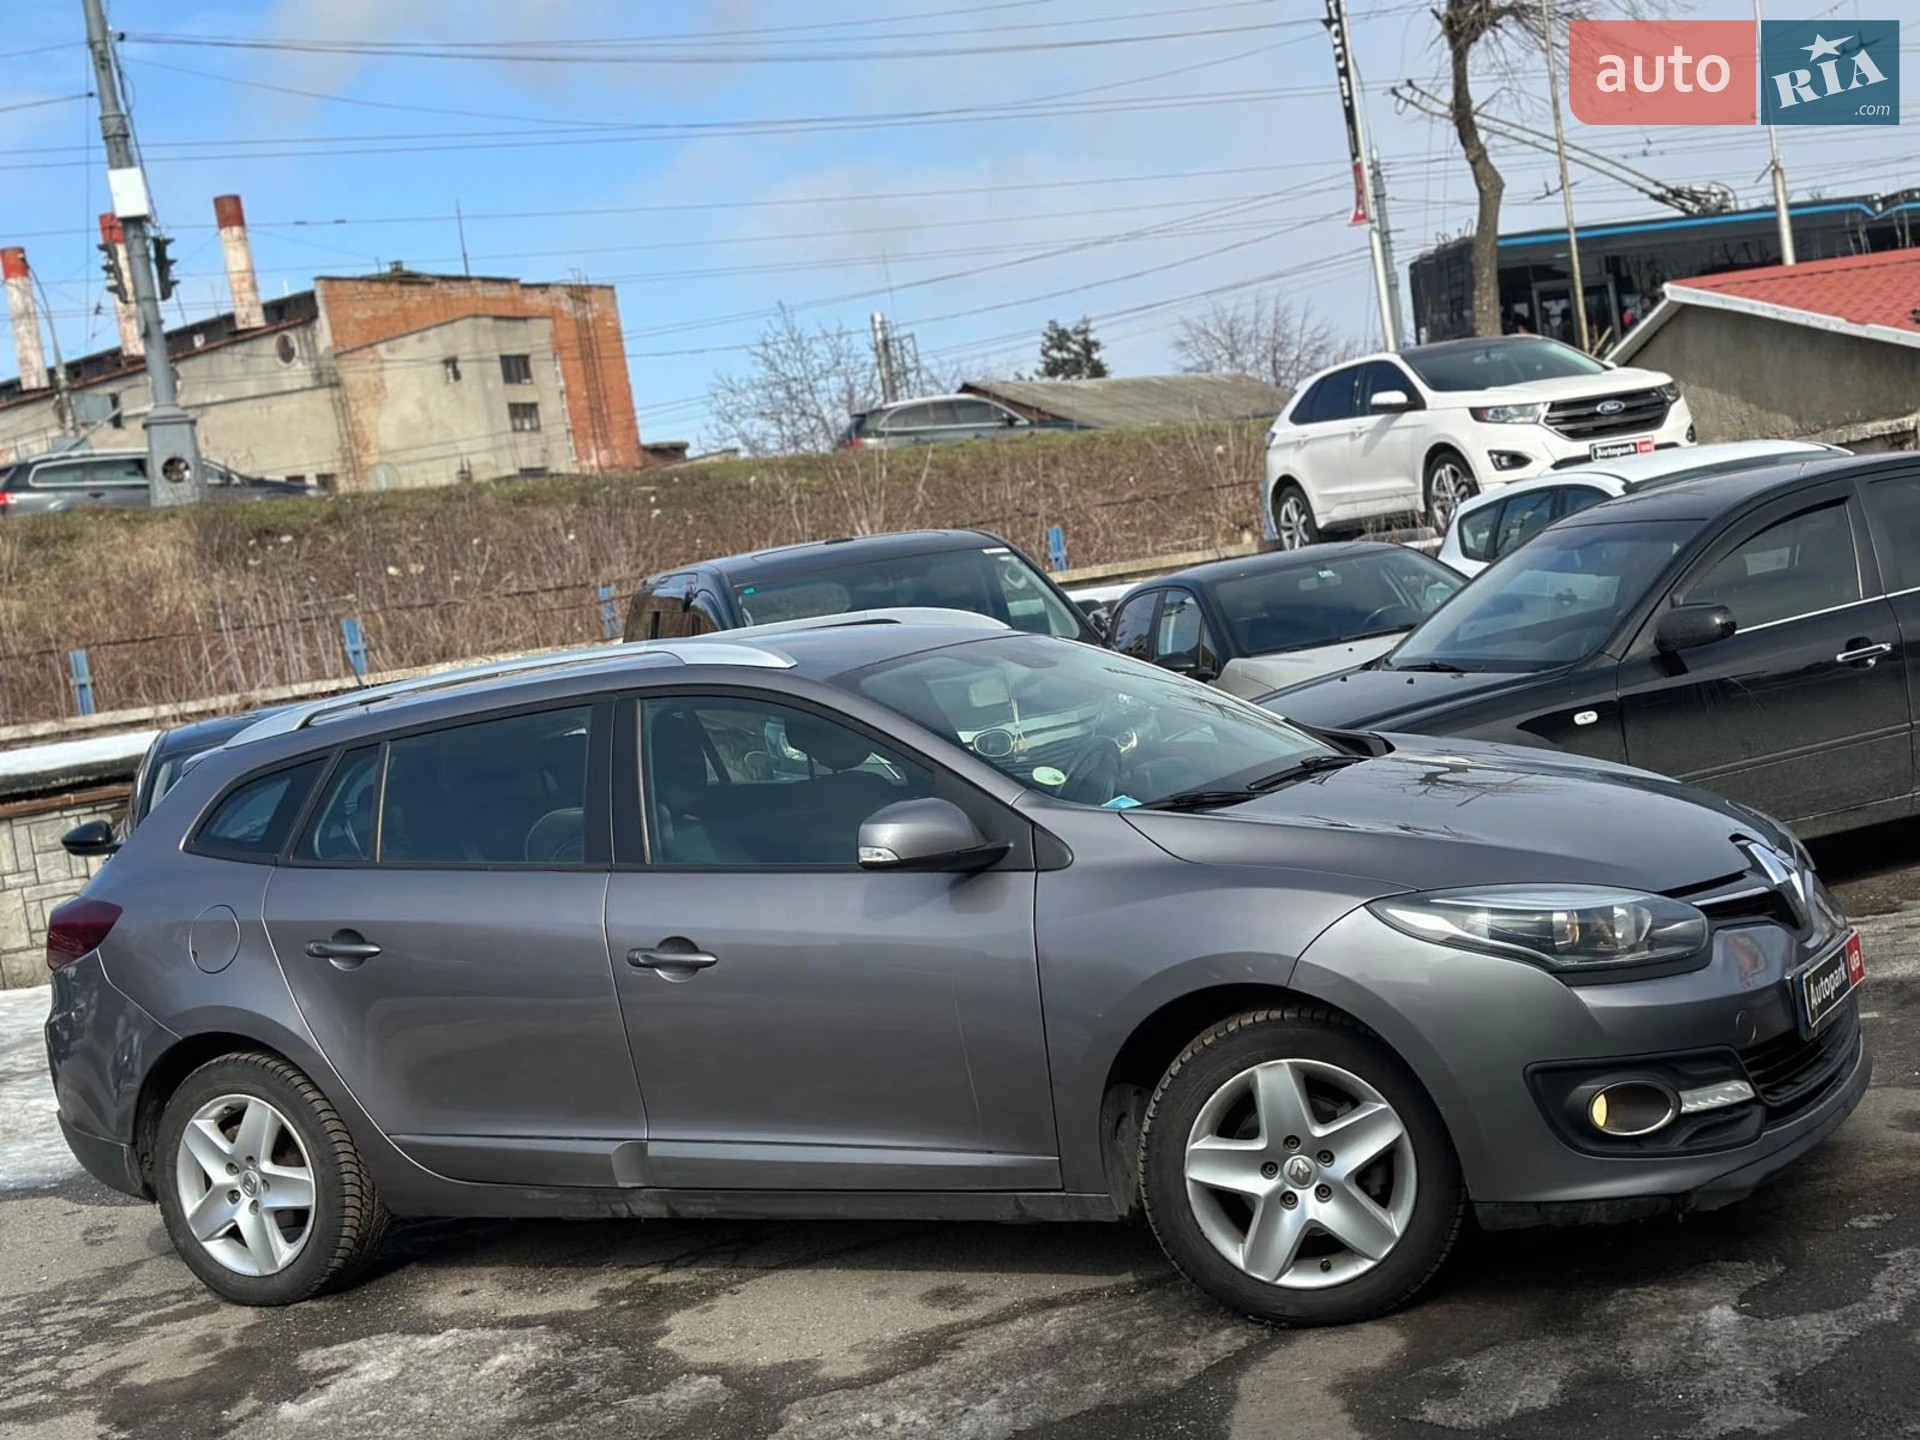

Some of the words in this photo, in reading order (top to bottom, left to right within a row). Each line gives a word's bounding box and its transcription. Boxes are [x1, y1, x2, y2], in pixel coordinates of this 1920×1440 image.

[1602, 402, 1620, 412] Ford
[1596, 445, 1636, 457] Autopark
[1810, 956, 1848, 1009] Autopark
